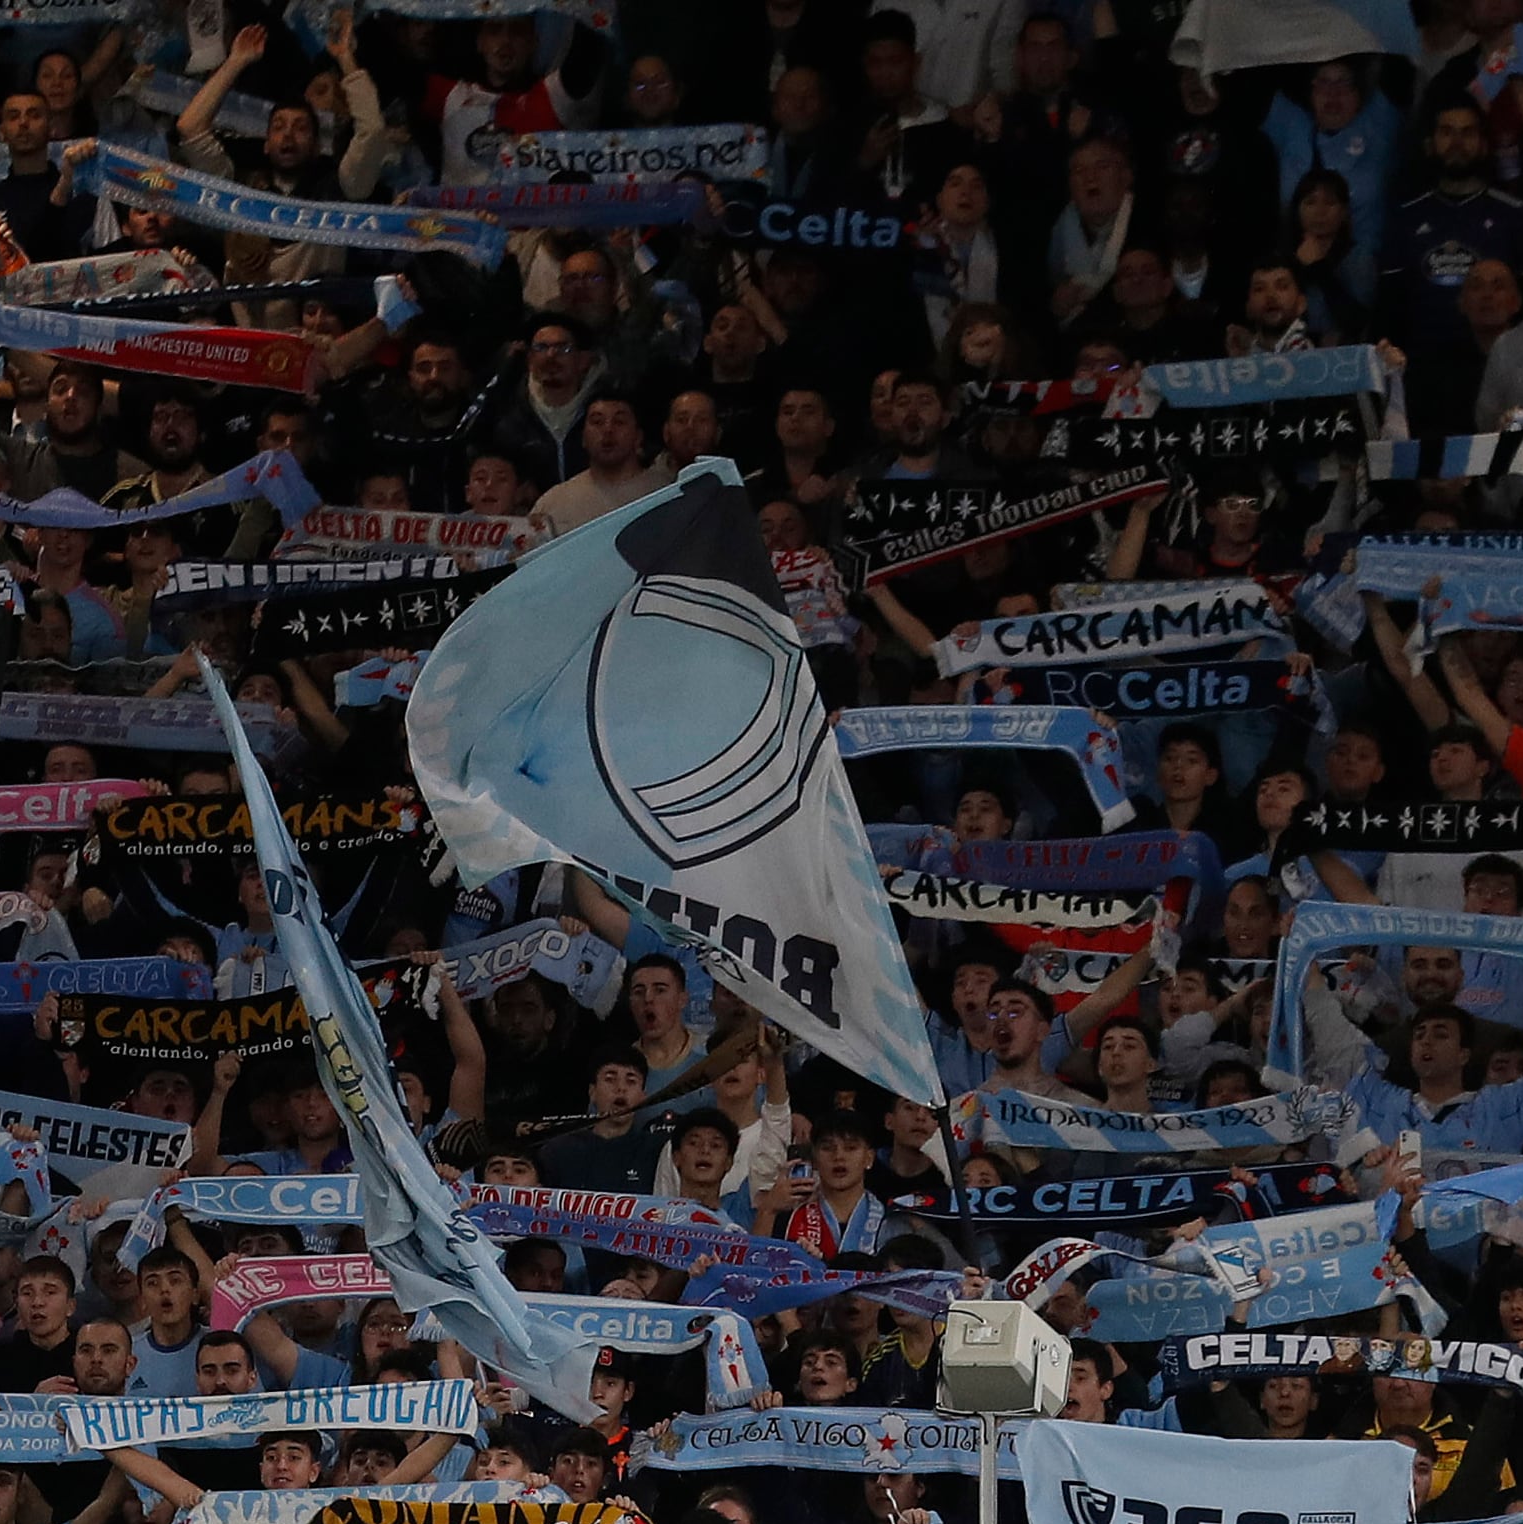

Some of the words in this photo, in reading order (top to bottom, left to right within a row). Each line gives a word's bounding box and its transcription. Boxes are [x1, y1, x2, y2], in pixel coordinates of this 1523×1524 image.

[205, 341, 251, 365] UNITED
[993, 597, 1278, 656] CARCAMÄN
[1045, 671, 1251, 712] RCCelta
[1215, 1103, 1276, 1126] 1923
[1029, 1175, 1197, 1214] CELTA
[1186, 1332, 1335, 1371] CELTA
[690, 1411, 784, 1449] CELTA
[792, 1419, 867, 1450] VIGO
